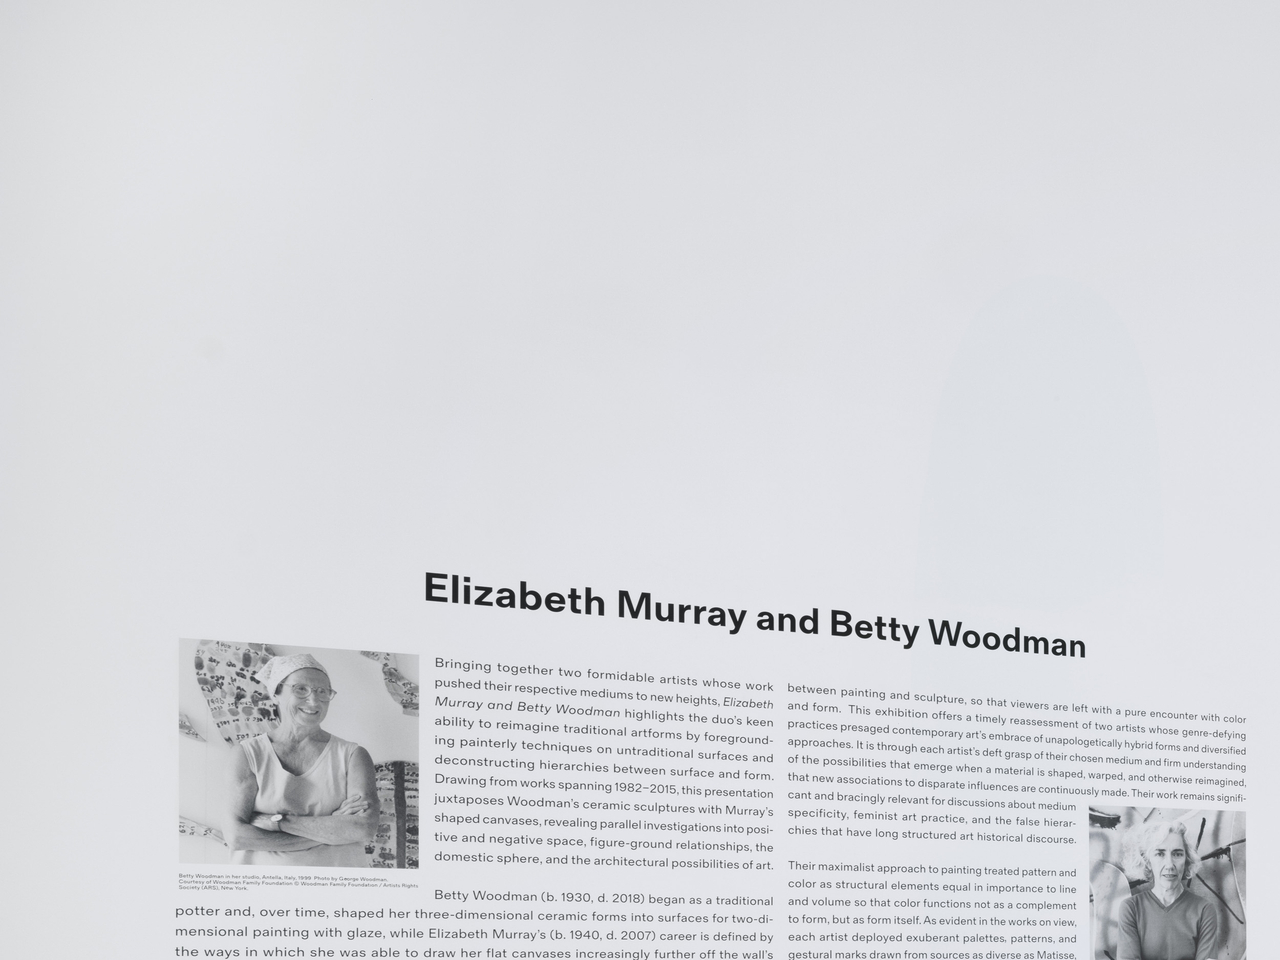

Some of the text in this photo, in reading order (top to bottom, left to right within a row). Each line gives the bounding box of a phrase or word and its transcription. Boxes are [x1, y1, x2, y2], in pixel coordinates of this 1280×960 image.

[424, 571, 1086, 658] Elizabeth Murray and Betty Woodman
[434, 656, 774, 692] Bringing together two formidable artists whose work
[786, 682, 1247, 724] between painting and sculpture, so that viewers are left with a pure encounter with color
[433, 715, 773, 745] ability to reimagine traditional artforms by foreground-
[434, 772, 773, 799] Drawing from works spanning 1982–2015, this presentation
[787, 807, 1076, 828] specificity, feminist art practice, and the false hierar-
[433, 831, 774, 854] tive and negative space, figure-ground relationships, the
[787, 859, 1077, 878] Their maximalist approach to painting treated pattern and
[174, 905, 773, 924] potter and, over time, shaped her three-dimensional ceramic forms into surfaces for two-di-
[787, 931, 1077, 945] each artist deployed exuberant palettes, patterns, and
